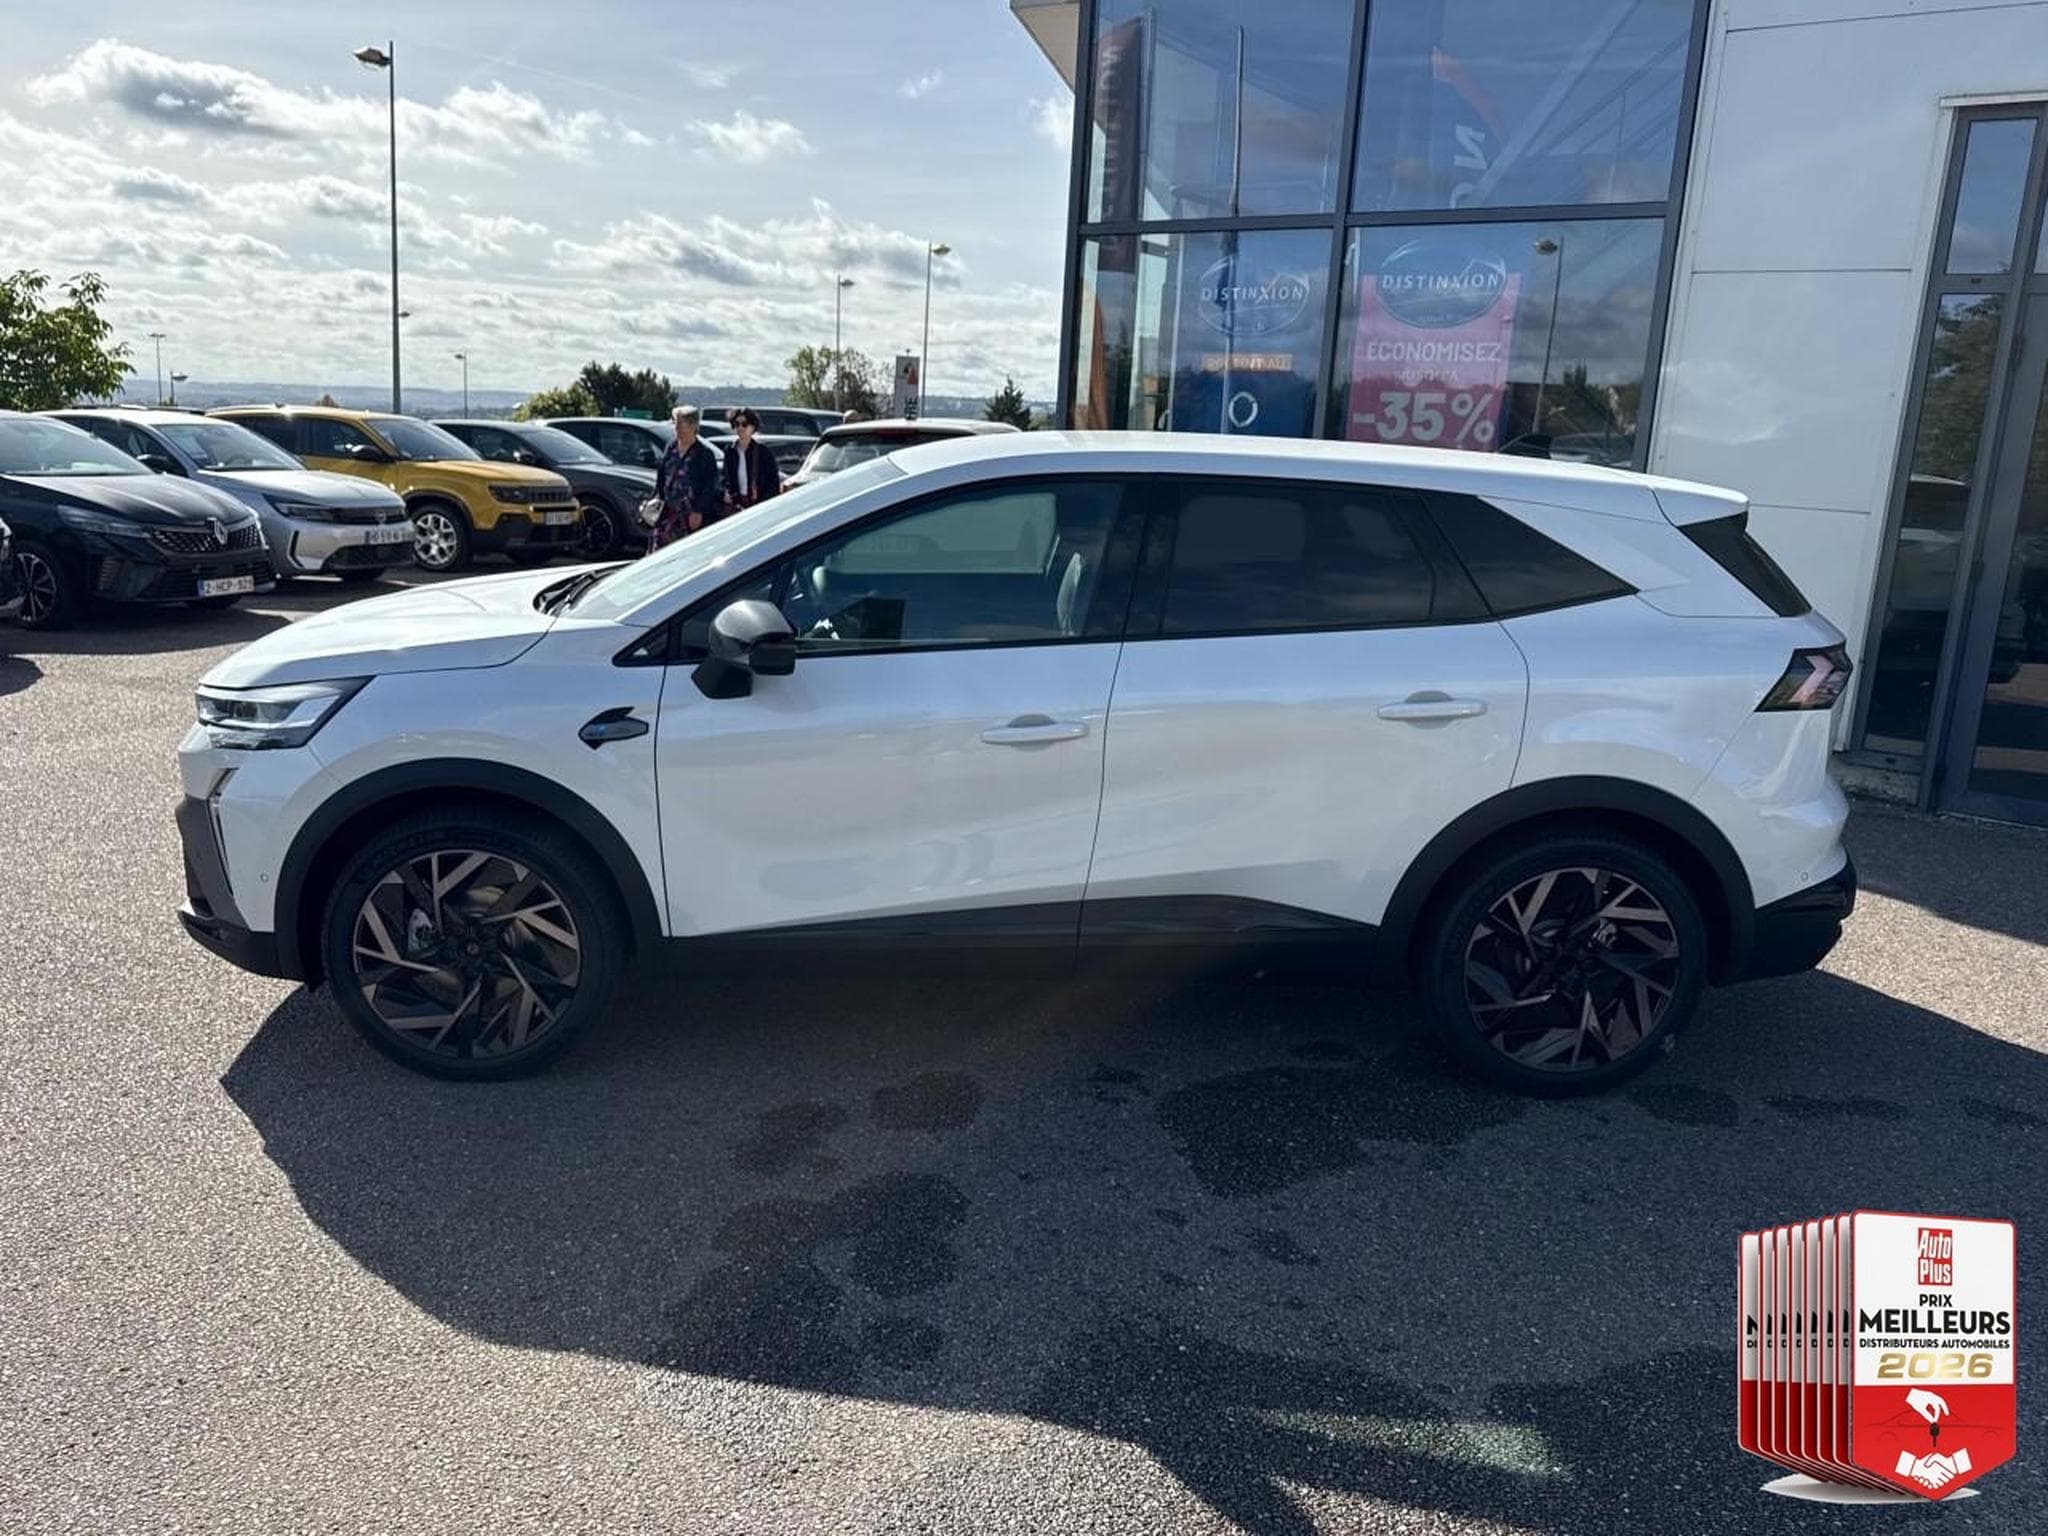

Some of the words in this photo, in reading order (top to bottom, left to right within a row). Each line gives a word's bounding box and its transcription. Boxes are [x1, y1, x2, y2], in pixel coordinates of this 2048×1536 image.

[1381, 273, 1499, 290] DISTINXION
[1201, 285, 1304, 303] DISTINXION
[1353, 390, 1496, 443] -35%
